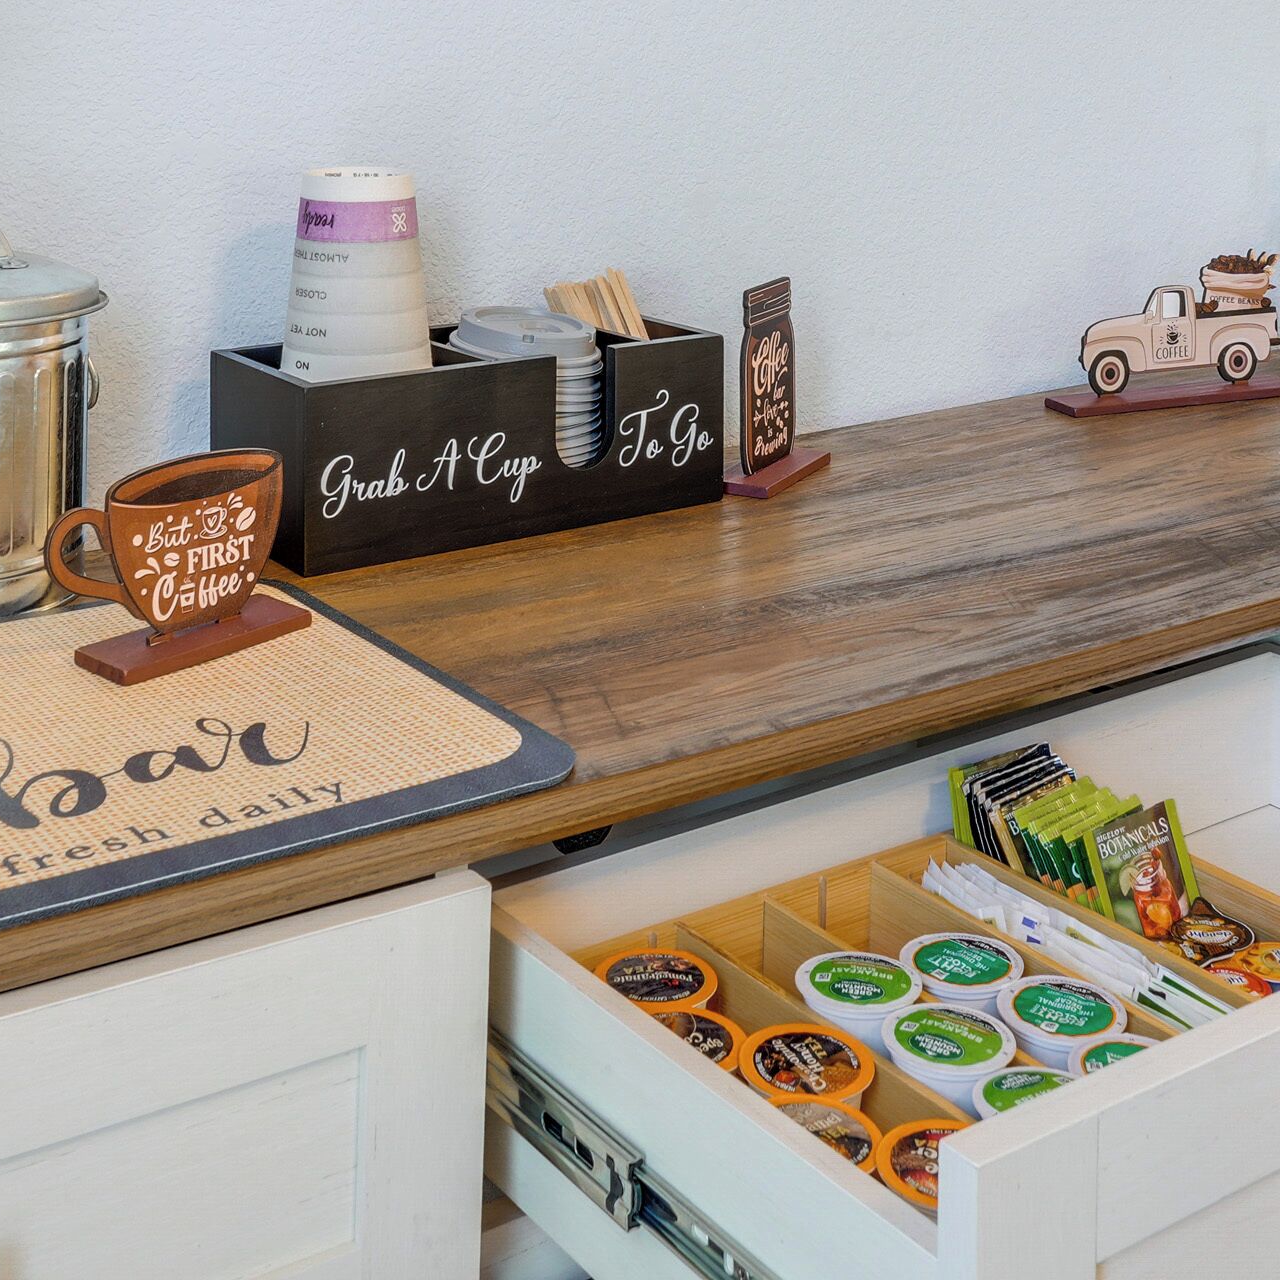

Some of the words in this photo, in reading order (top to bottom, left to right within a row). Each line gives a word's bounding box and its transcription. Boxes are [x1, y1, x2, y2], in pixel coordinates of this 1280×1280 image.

[303, 202, 335, 235] ready
[309, 253, 349, 263] ALMOST
[296, 288, 327, 300] CLOSER
[1210, 295, 1235, 303] COFFEE
[290, 323, 303, 334] YET
[306, 328, 326, 337] NOT
[1156, 345, 1189, 360] COFFEE
[296, 361, 309, 370] NO
[752, 330, 789, 396] Coffee
[619, 389, 669, 467] To
[670, 404, 713, 467] Go
[767, 426, 773, 437] is
[754, 426, 788, 456] Brewing
[320, 449, 410, 519] Grab
[417, 438, 462, 491] A
[467, 432, 542, 503] Cup
[144, 516, 193, 553] But
[187, 534, 255, 575] FIRST
[0, 822, 172, 877] fresh
[198, 780, 345, 829] daily
[1096, 826, 1126, 842] BIGELOW
[1098, 817, 1169, 859] BOTANICALS
[623, 963, 653, 974] TEA
[830, 967, 894, 980] BREAKFAST
[613, 971, 693, 984] Pomegranate
[834, 983, 880, 993] MOUNTAIN
[841, 988, 872, 996] GREEN
[920, 1018, 983, 1043] BREAKFAST
[915, 1035, 961, 1054] MOUNTAIN
[919, 1042, 951, 1056] GREEN
[793, 1041, 824, 1074] Honey
